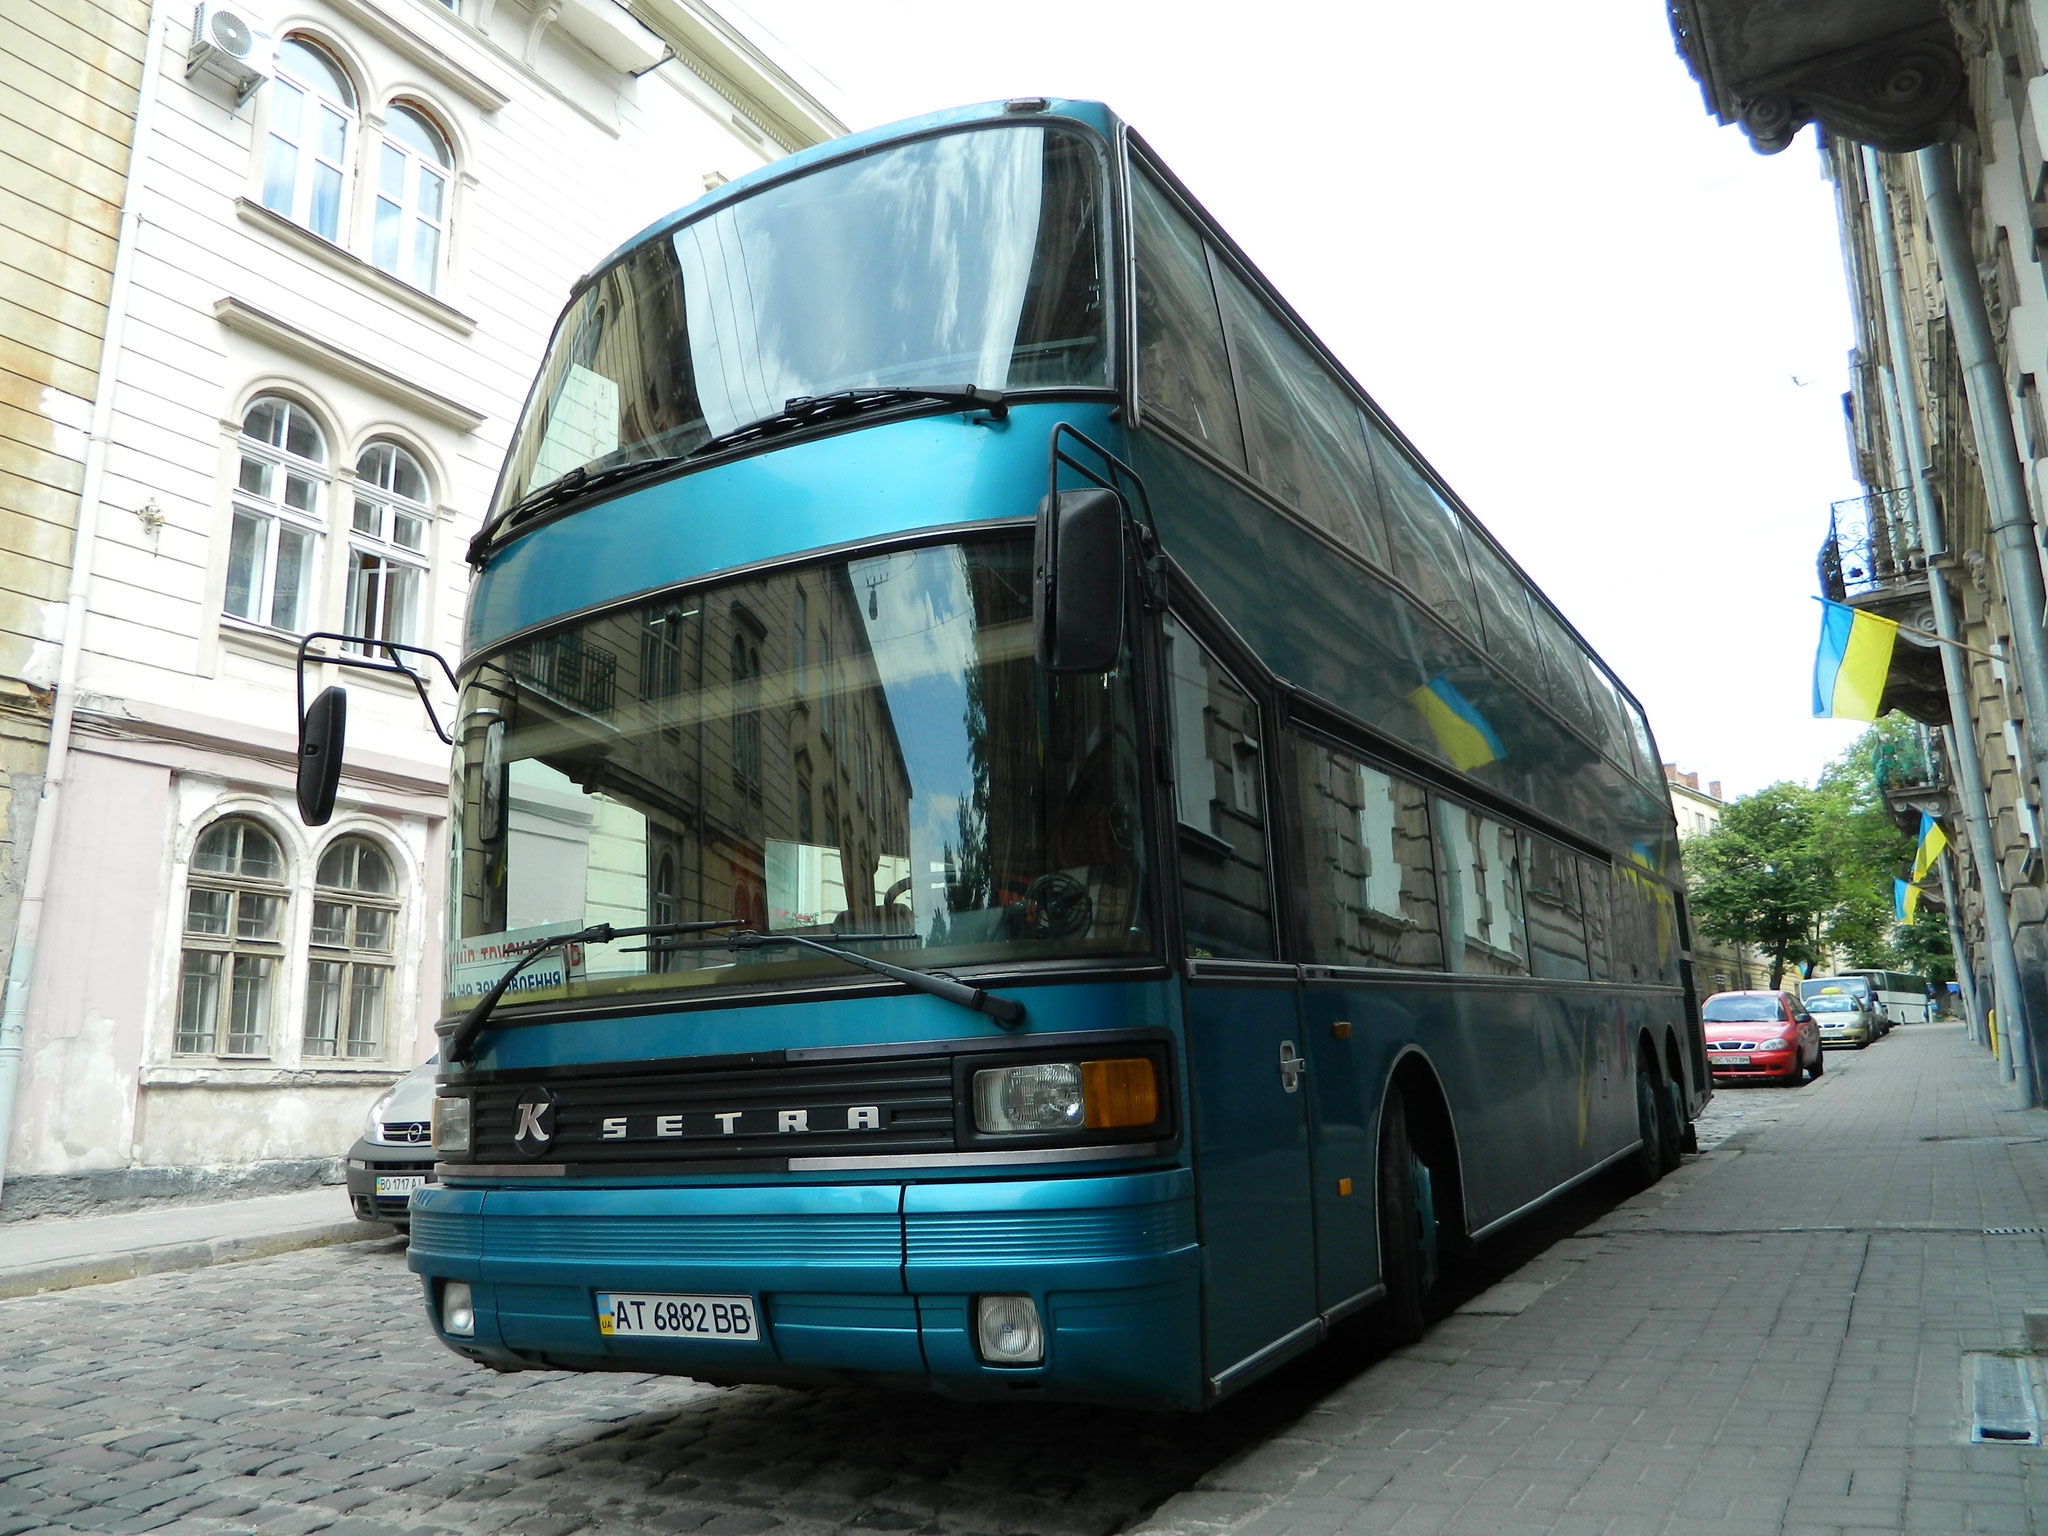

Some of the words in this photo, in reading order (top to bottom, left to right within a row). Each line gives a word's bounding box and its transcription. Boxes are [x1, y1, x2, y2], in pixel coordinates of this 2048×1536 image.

[476, 971, 561, 996] ЗАМВЛЕННЯ
[602, 1106, 881, 1139] SETRA
[393, 1178, 409, 1190] 1717
[601, 1321, 612, 1329] UA
[616, 1301, 646, 1330] AT
[654, 1302, 709, 1332] 6882
[712, 1303, 751, 1334] BB
